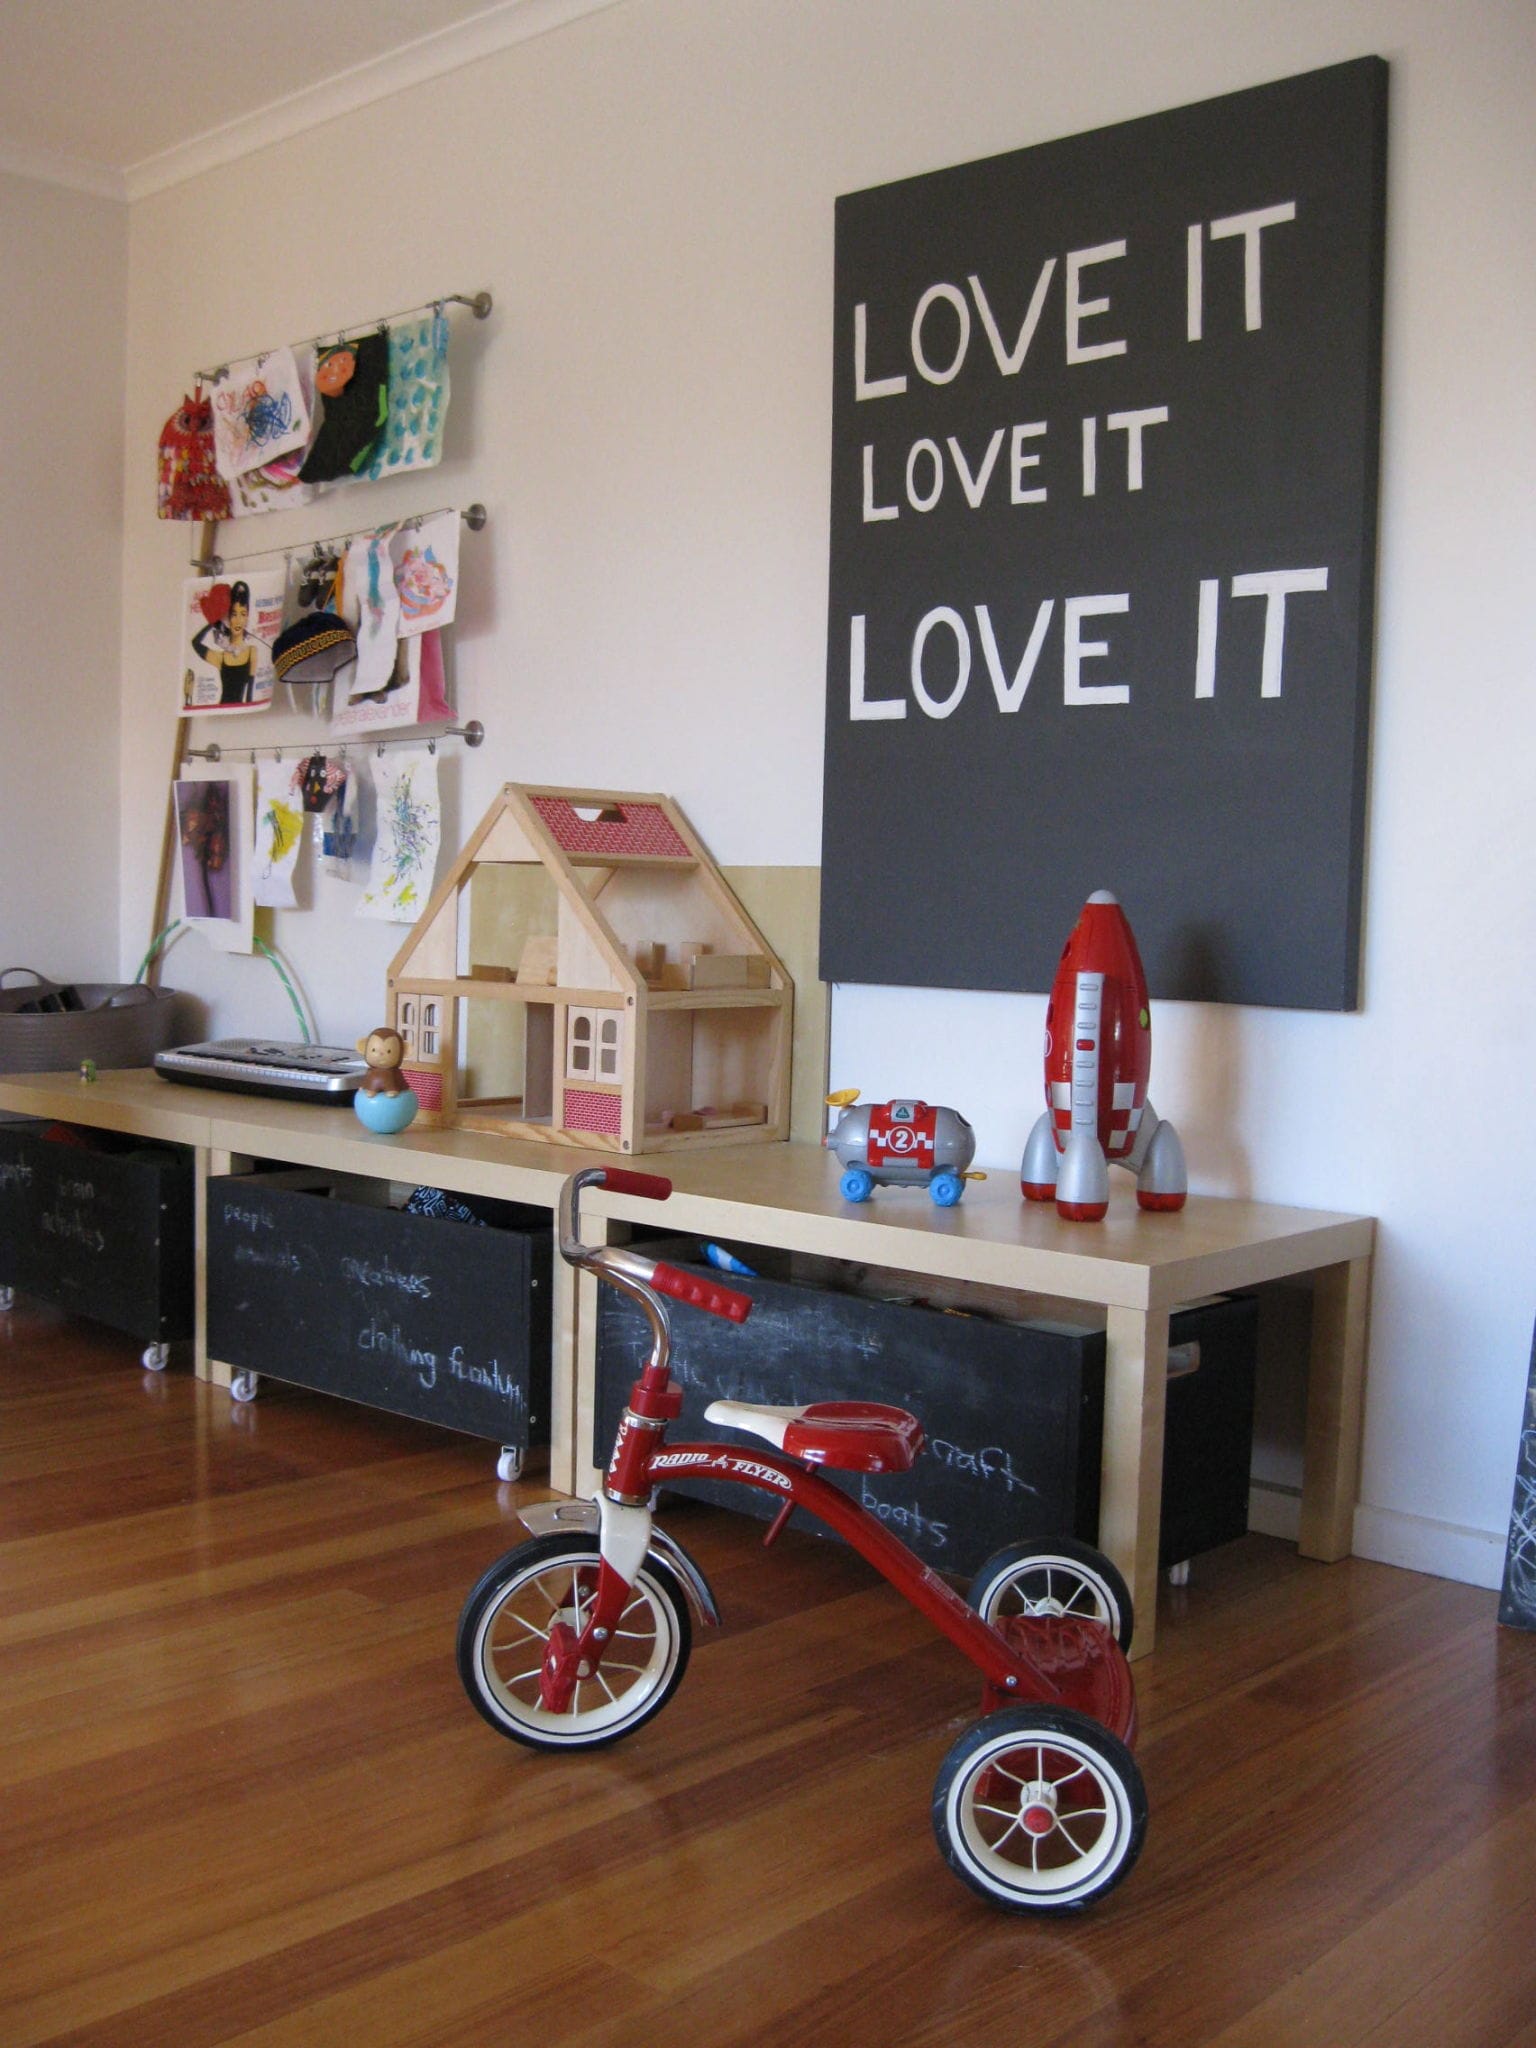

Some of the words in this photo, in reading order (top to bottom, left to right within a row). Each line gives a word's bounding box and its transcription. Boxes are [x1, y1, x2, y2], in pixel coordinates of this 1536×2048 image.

[855, 238, 1127, 401] LOVE
[1187, 201, 1296, 342] IT
[863, 421, 1047, 523] LOVE
[1082, 406, 1169, 497] IT
[850, 593, 1130, 720] LOVE
[1195, 567, 1328, 699] IT
[895, 1130, 908, 1149] 2
[648, 1452, 711, 1470] RADIO
[732, 1461, 792, 1489] FLYER
[862, 1474, 949, 1548] boats
